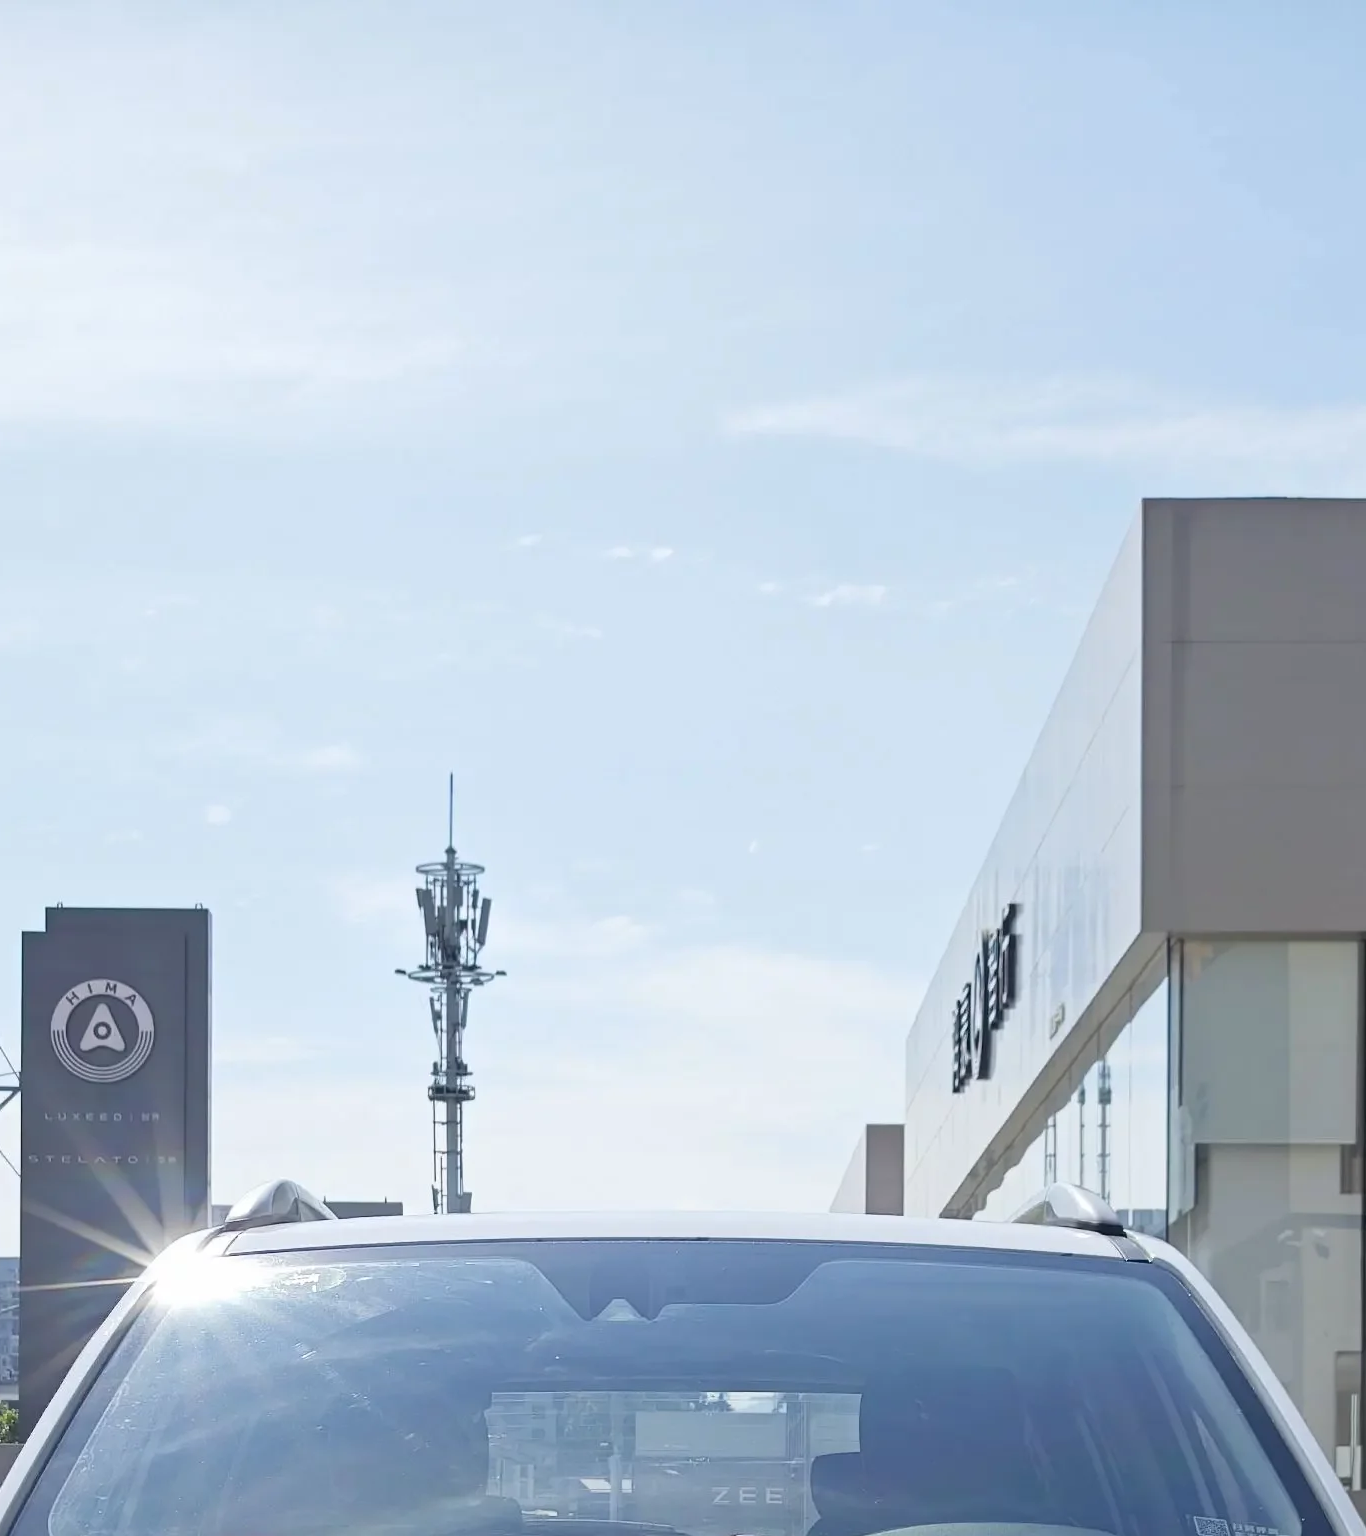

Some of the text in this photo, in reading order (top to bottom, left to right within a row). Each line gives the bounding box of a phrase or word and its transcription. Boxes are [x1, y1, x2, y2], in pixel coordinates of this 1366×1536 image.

[65, 982, 137, 1006] HIMA
[44, 1111, 122, 1122] LUXEED
[28, 1154, 138, 1164] STELATO
